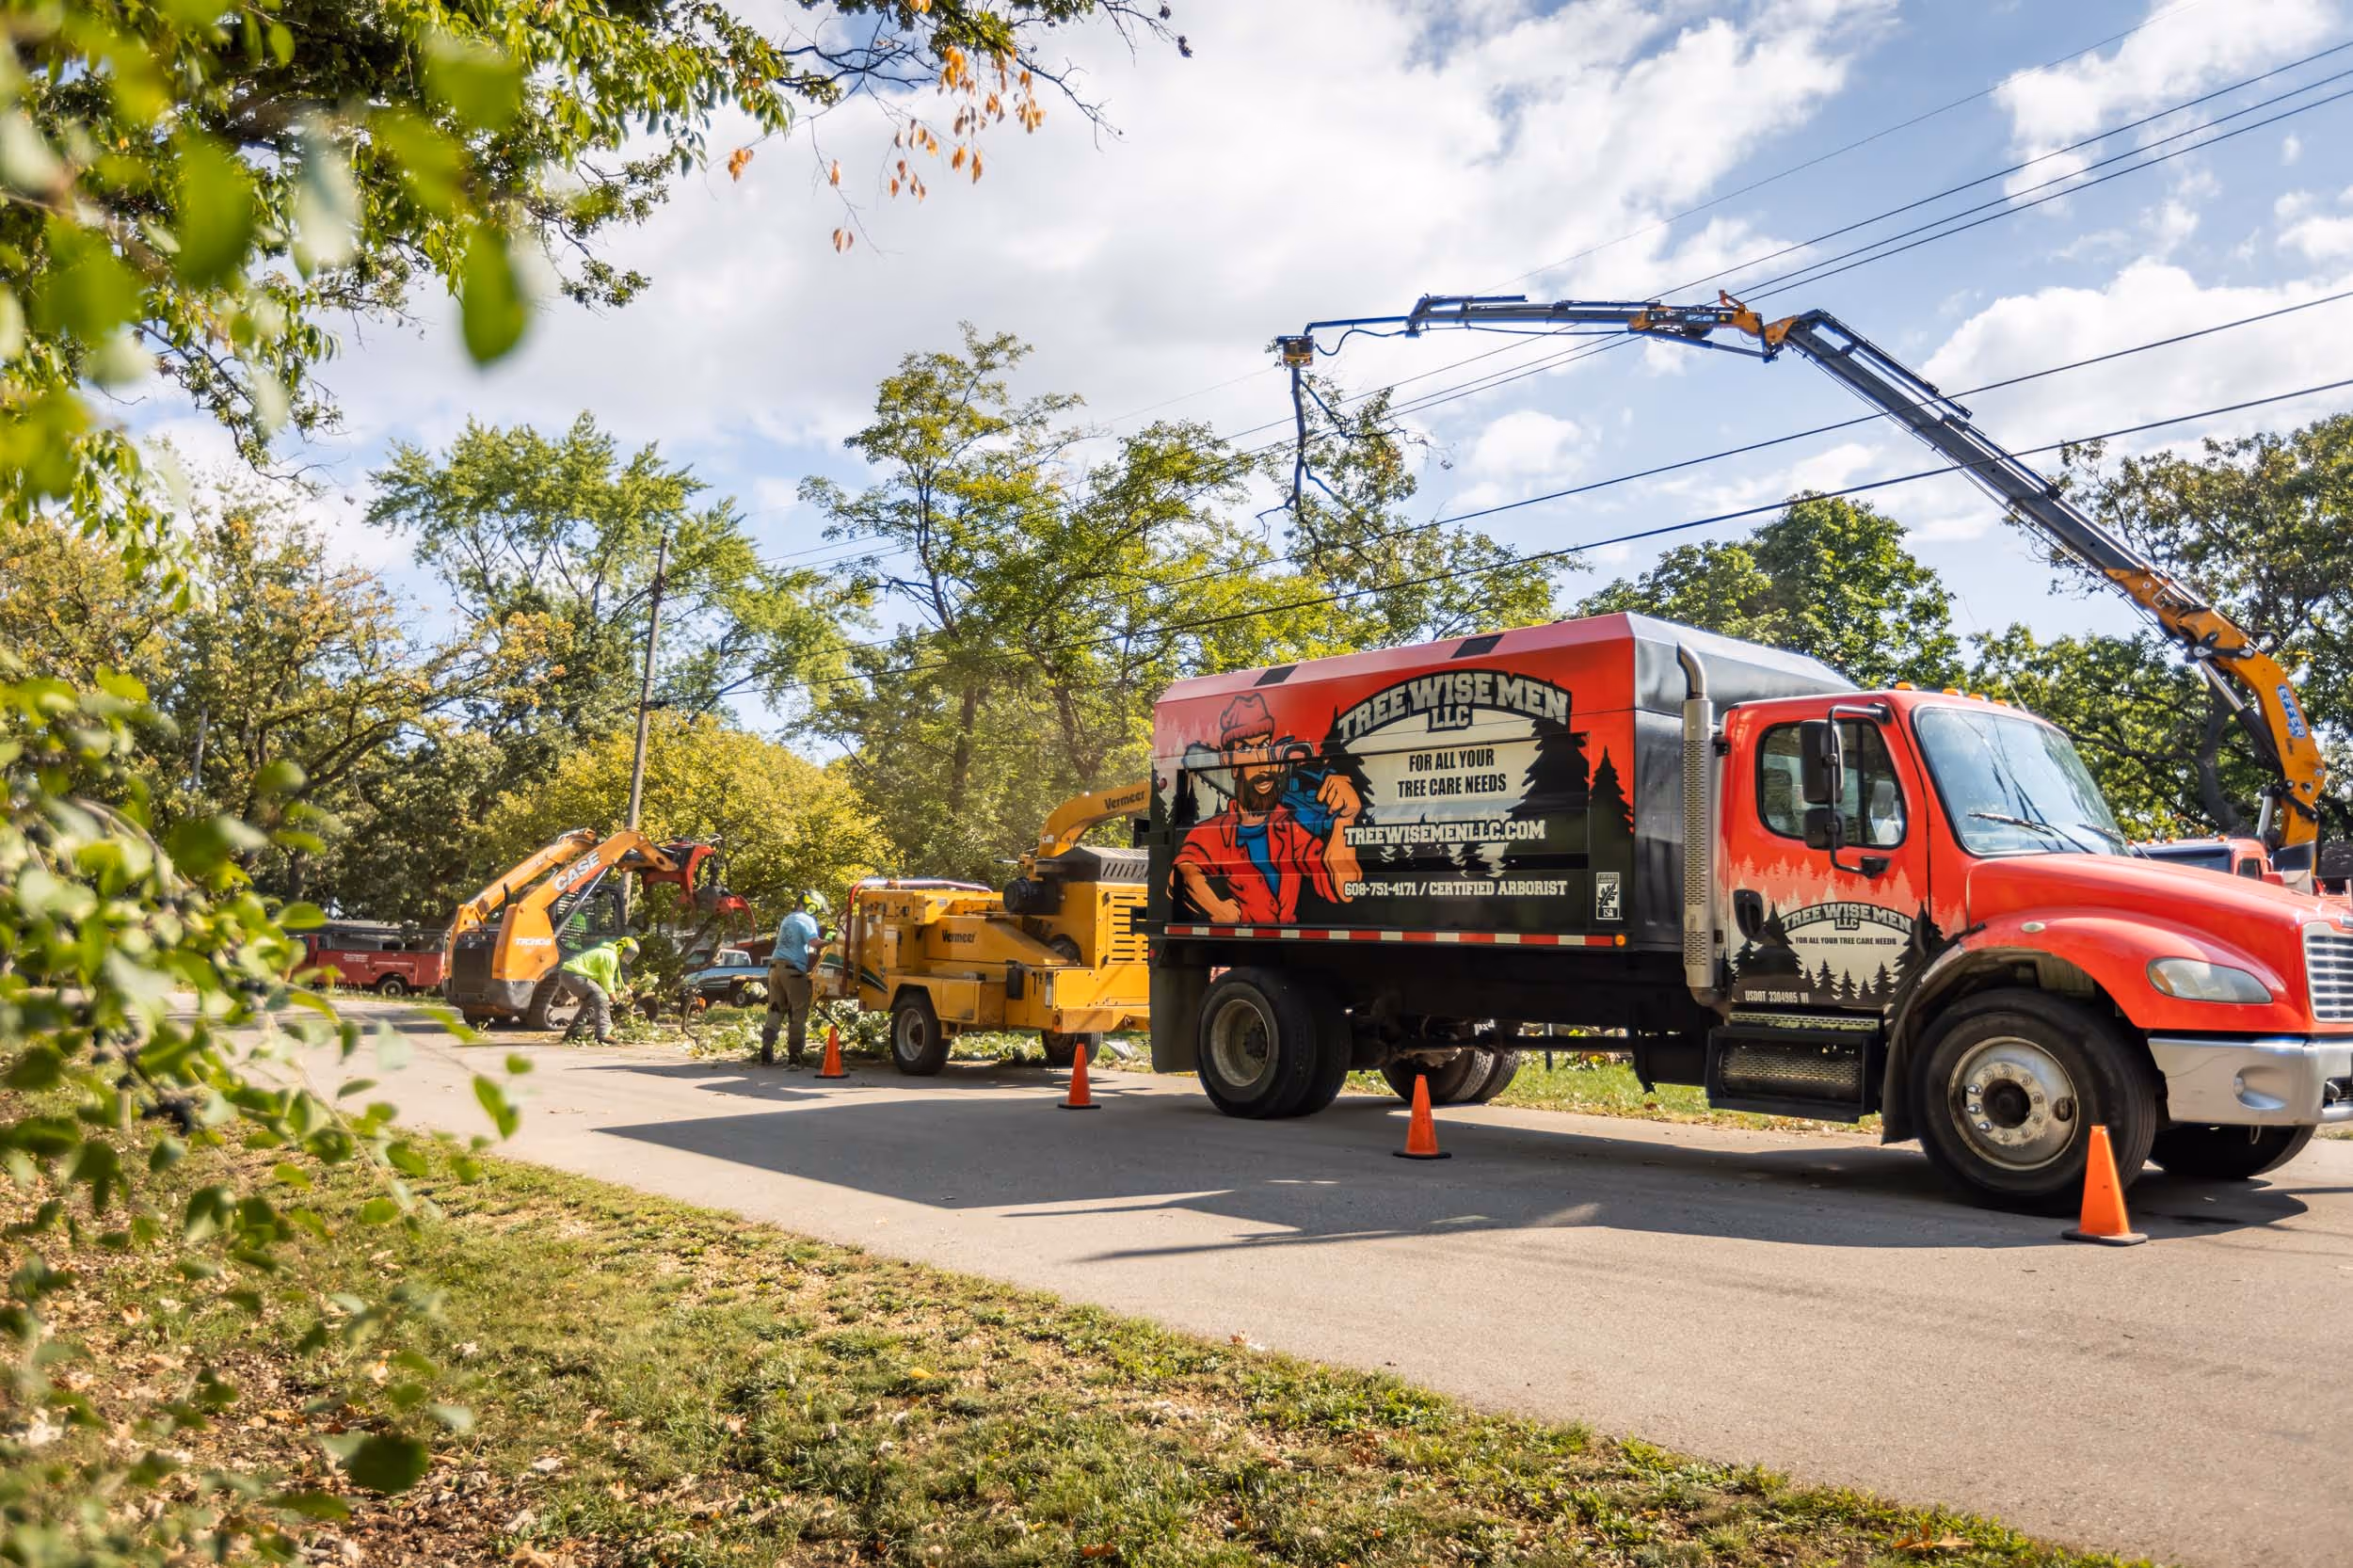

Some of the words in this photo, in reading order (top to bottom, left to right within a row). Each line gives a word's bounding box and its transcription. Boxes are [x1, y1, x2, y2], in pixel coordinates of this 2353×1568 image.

[1337, 685, 1410, 739] TREE
[1409, 673, 1493, 708] WISE
[1496, 674, 1568, 726] MEN
[1432, 706, 1470, 728] LLC
[2278, 688, 2306, 737] EFFER
[1409, 754, 1433, 772] FOR
[1435, 752, 1456, 770] ALL
[1459, 748, 1495, 768] YOUR
[1397, 779, 1426, 798] TREE
[1429, 776, 1462, 796] CARE
[1465, 774, 1507, 793] NEEDS
[1104, 791, 1145, 810] Vermeer
[1344, 820, 1546, 845] TREEWISEMENLLC.COM
[554, 851, 600, 891] CASE
[1344, 882, 1417, 897] 608-751-4171
[1419, 881, 1427, 896] /
[1429, 881, 1495, 896] CERTIFIED
[1497, 880, 1568, 896] ARBORIST
[1781, 906, 1821, 931] TREE
[1822, 903, 1870, 919] WISE
[1872, 906, 1913, 934] MEN
[1836, 918, 1859, 929] LLC
[941, 929, 976, 944] Vermeer
[1745, 990, 1767, 1002] USDOT
